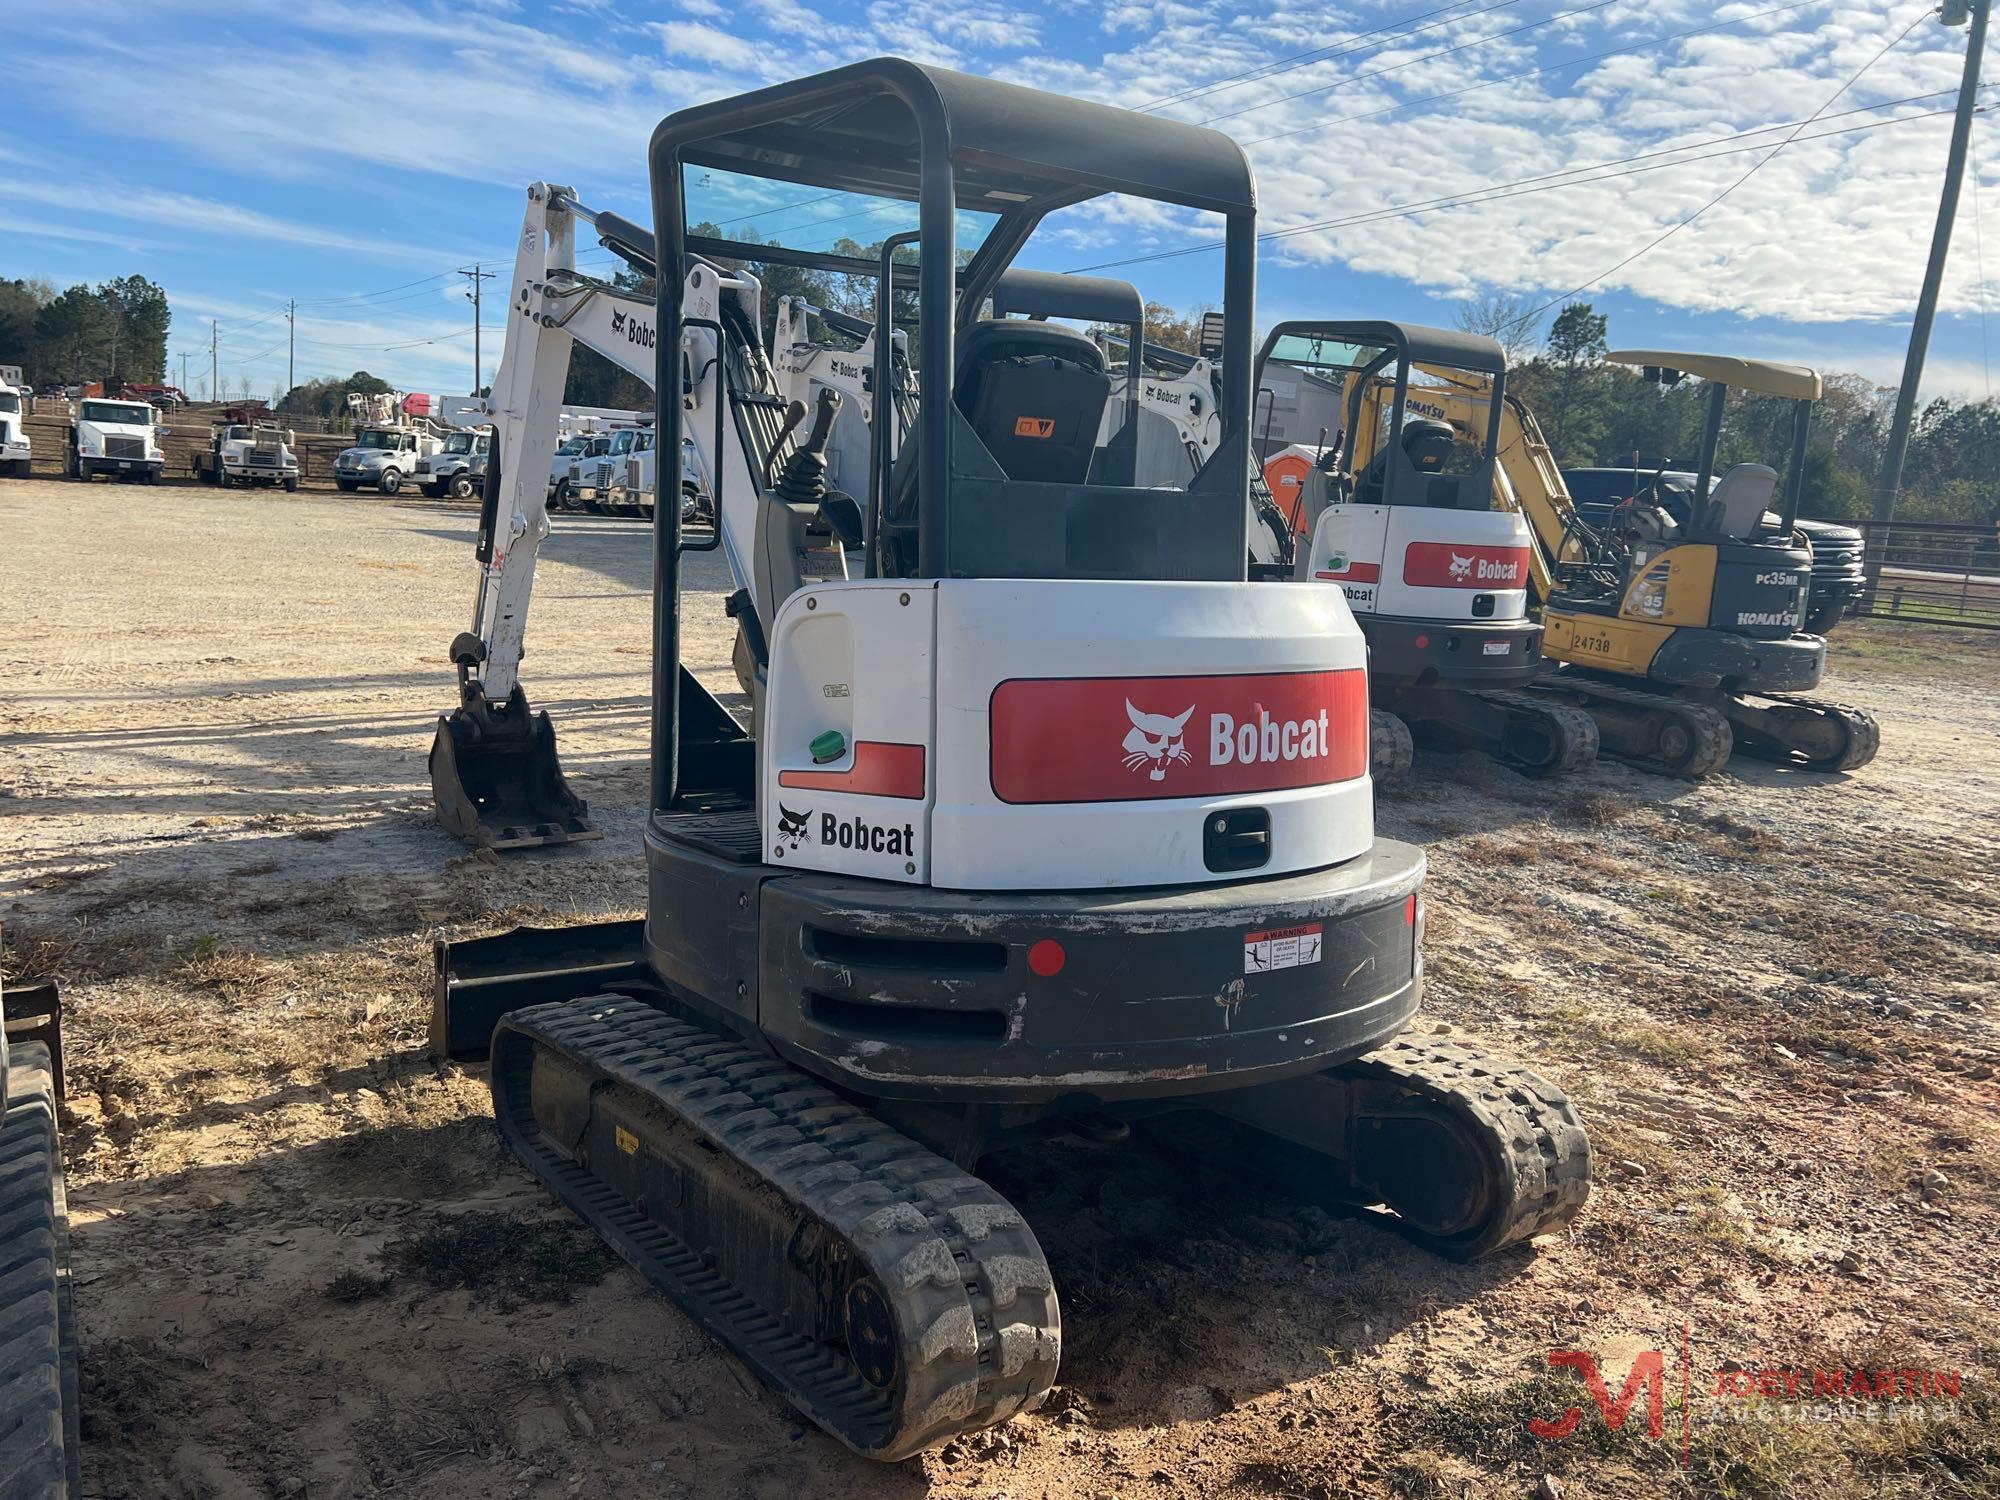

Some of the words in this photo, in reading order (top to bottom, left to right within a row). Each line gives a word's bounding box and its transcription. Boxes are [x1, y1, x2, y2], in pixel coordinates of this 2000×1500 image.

[629, 317, 656, 349] Bobc
[1156, 388, 1182, 405] Bobcat
[1405, 399, 1445, 420] OMATSU
[1477, 559, 1519, 580] Bobcat
[1756, 571, 1799, 586] PC35MR
[1342, 586, 1373, 602] bcat
[1643, 595, 1663, 608] 35
[1737, 610, 1799, 627] KOMATSU
[1574, 635, 1610, 653] 24738
[1210, 708, 1329, 767] Bobcat
[821, 812, 914, 857] Bobcat
[1271, 926, 1308, 939] WARNING
